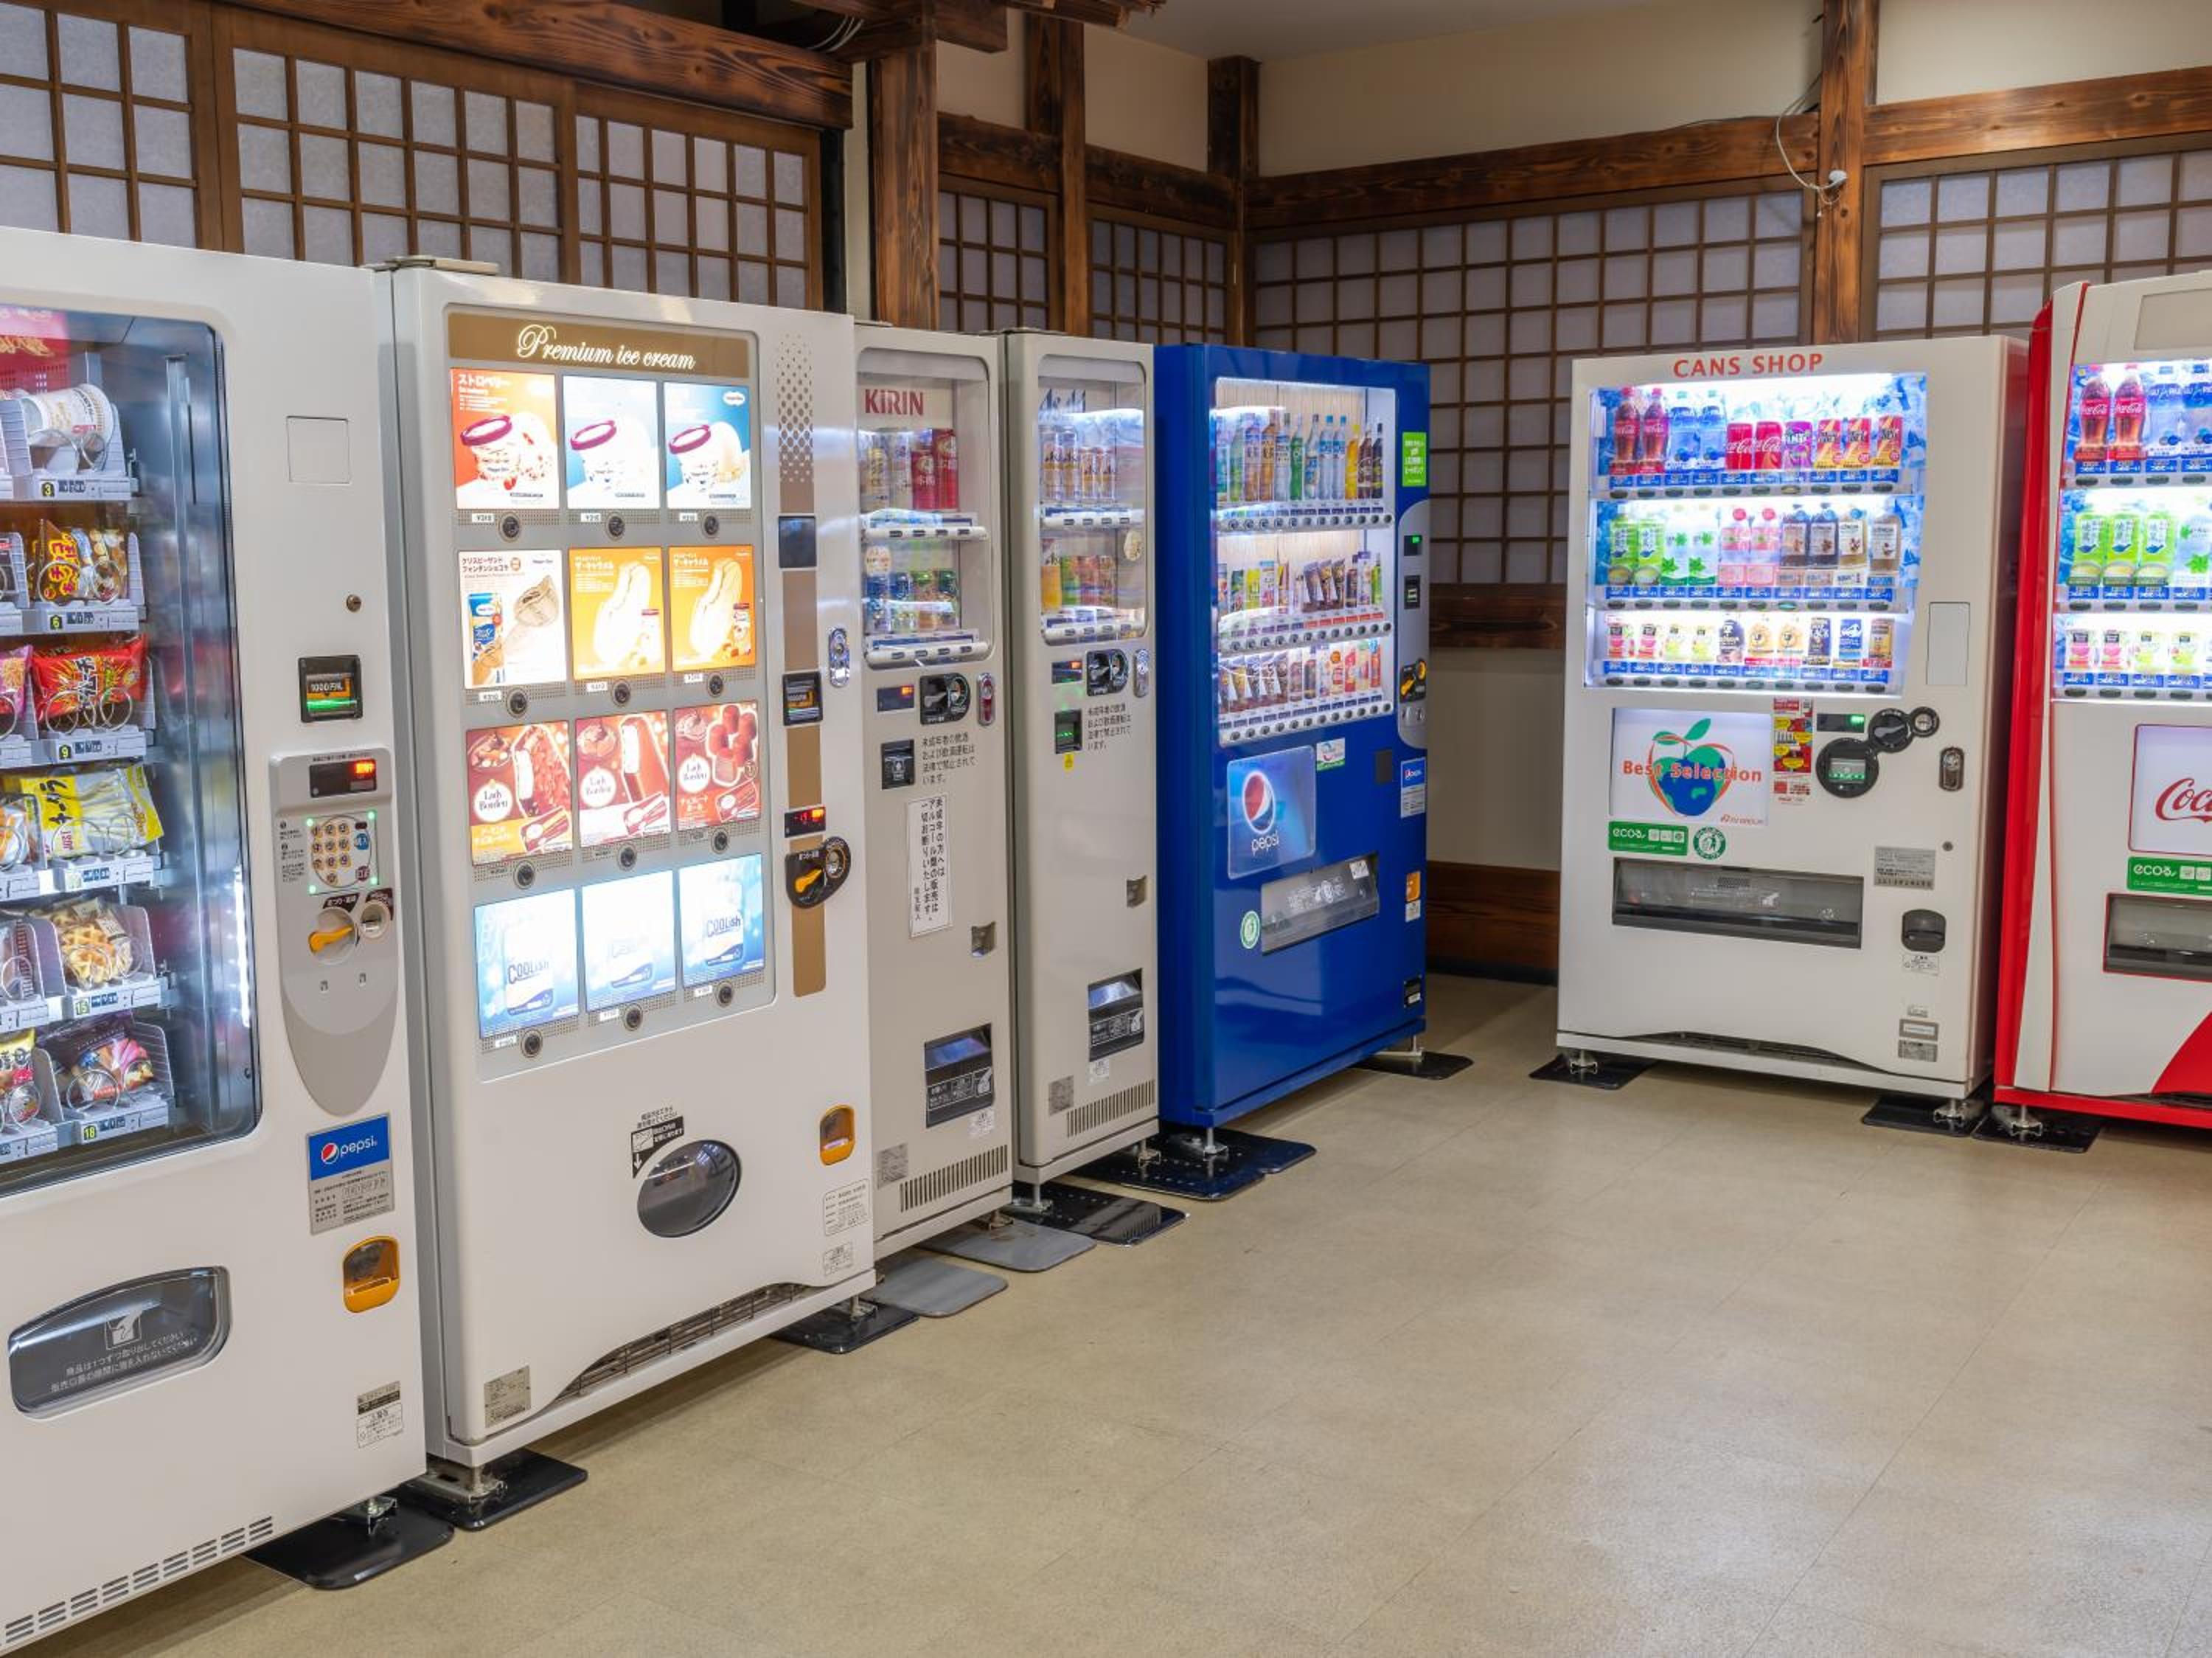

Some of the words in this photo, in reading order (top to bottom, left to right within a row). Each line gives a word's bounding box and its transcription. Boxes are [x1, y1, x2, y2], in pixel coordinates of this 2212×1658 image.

[518, 324, 614, 364] Premium
[616, 344, 639, 364] ice
[642, 350, 695, 370] cream
[1674, 359, 1741, 378] CANS
[1752, 353, 1823, 375] SHOP
[865, 389, 924, 416] KIRIN
[922, 732, 968, 746] 未成年者の飲酒
[922, 744, 975, 760] および飲酒運転は
[922, 756, 977, 772] 法律で禁止されて
[1623, 760, 1661, 779] Best
[1670, 762, 1761, 782] Selection
[60, 830, 73, 850] JUST
[1251, 831, 1279, 855] pepsi
[340, 1136, 374, 1159] pepsi
